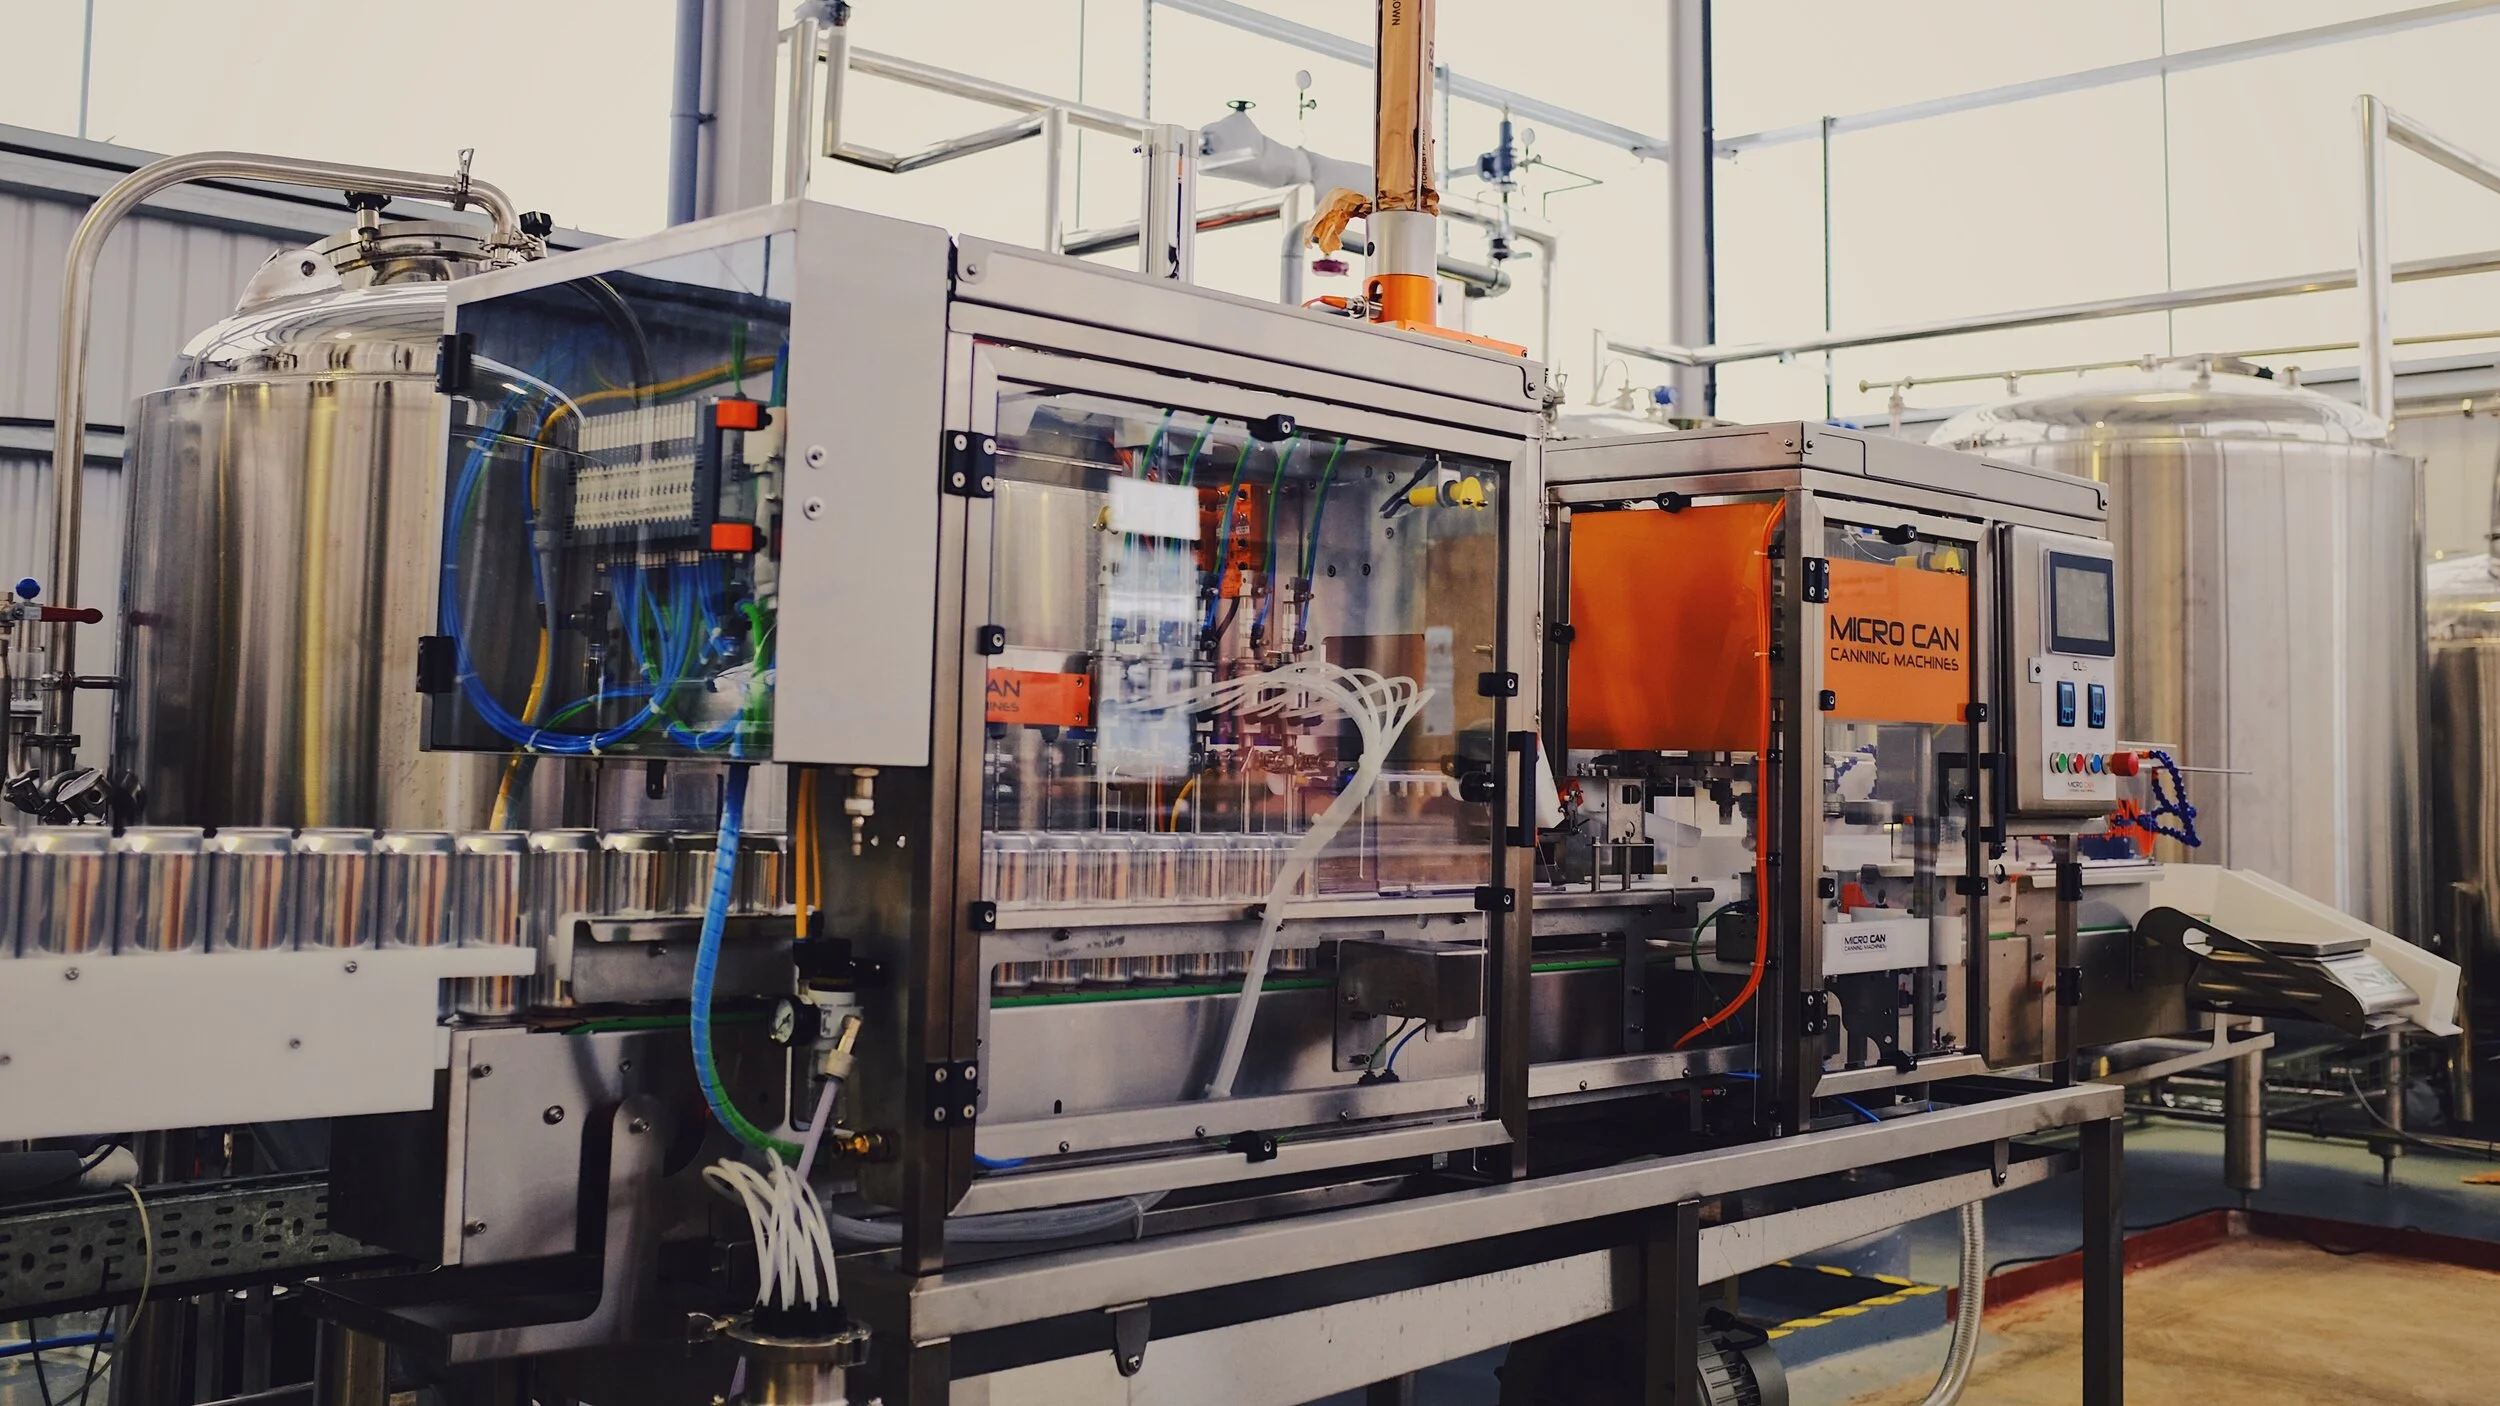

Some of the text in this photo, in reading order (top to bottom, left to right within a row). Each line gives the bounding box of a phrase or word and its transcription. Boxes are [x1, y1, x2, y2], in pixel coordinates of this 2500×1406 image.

[1391, 0, 1402, 26] OWN
[1830, 614, 1959, 652] MICRO CAN
[1830, 647, 1959, 671] CANNING MACHINES
[987, 679, 1020, 698] AN
[1844, 934, 1886, 944] MICRO CAN
